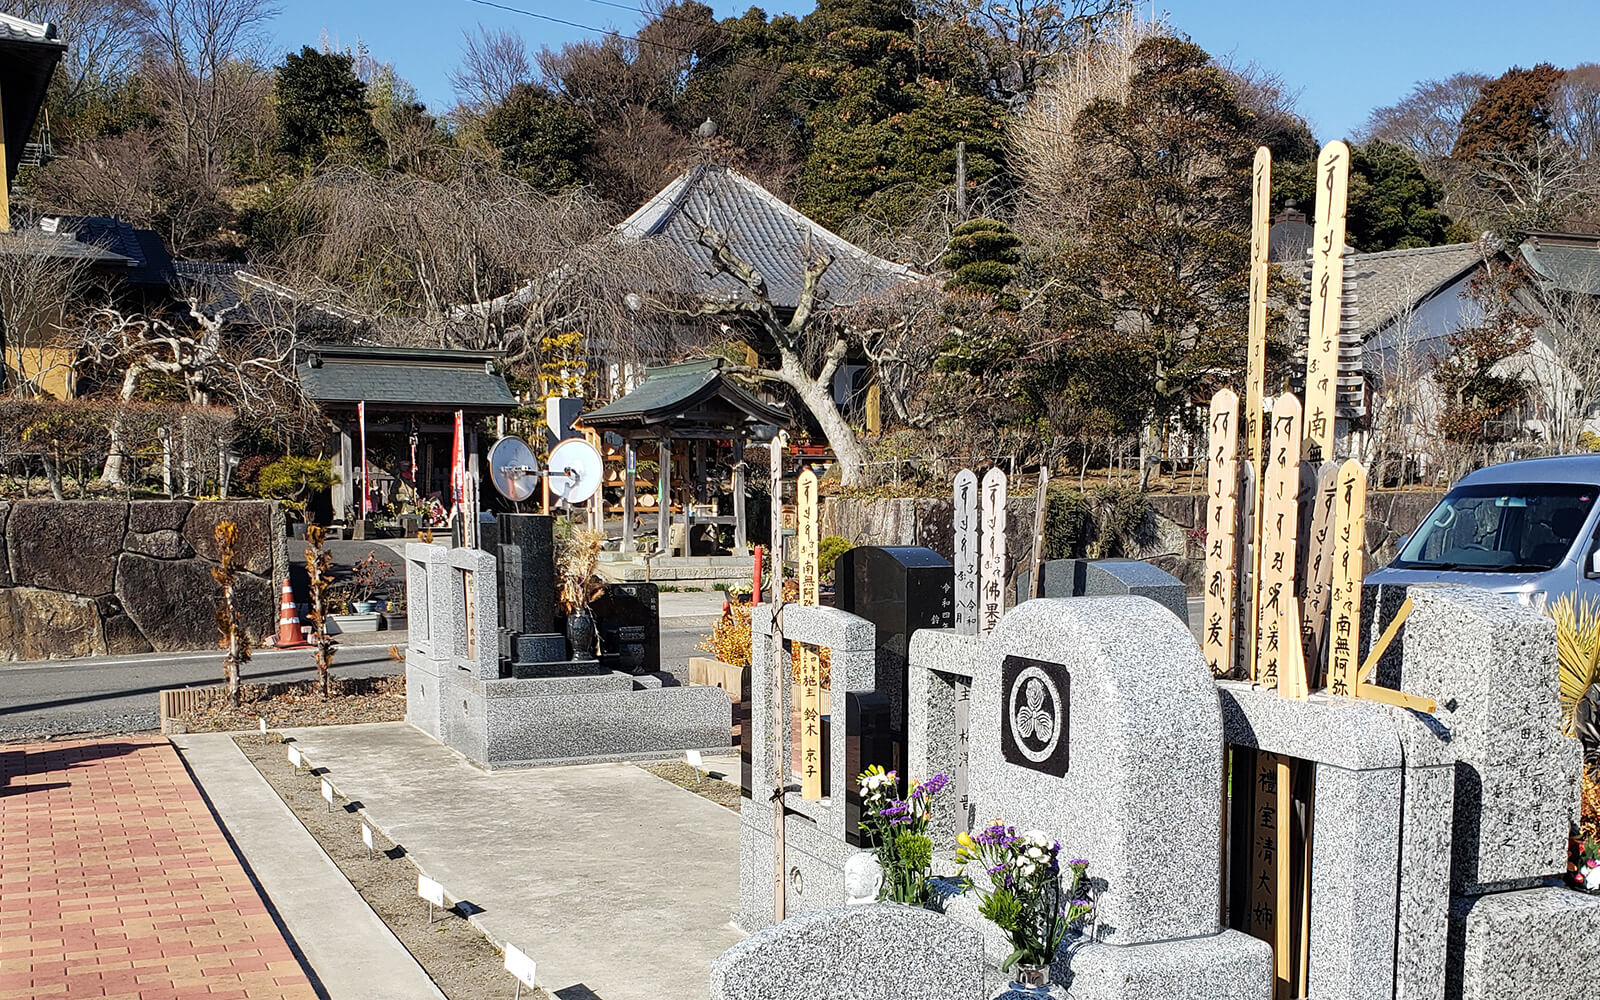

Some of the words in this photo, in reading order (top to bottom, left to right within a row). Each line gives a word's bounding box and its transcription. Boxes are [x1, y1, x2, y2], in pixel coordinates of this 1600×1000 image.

[1332, 613, 1352, 697] 南無阿弥
[802, 674, 818, 698] 施主
[803, 707, 819, 737] 鈴木
[804, 747, 818, 778] 京子
